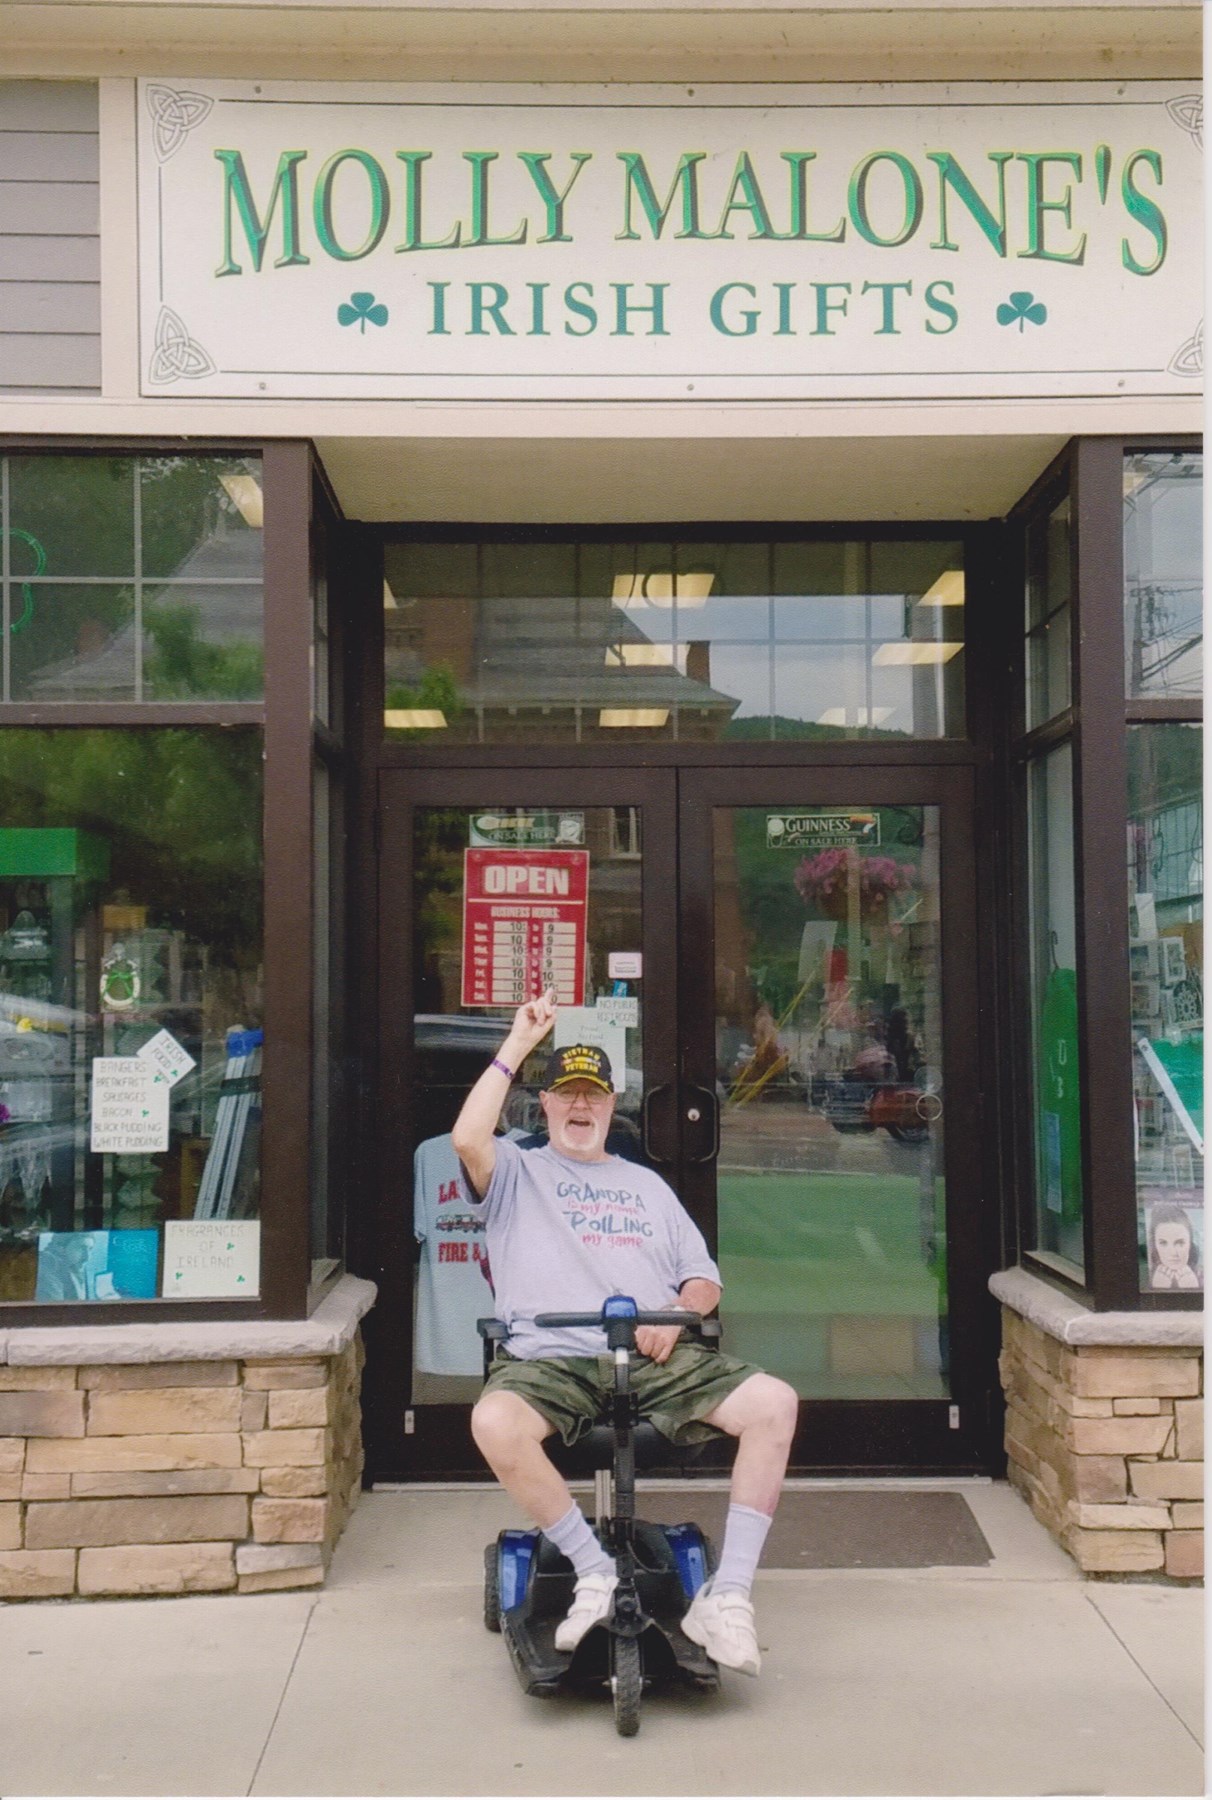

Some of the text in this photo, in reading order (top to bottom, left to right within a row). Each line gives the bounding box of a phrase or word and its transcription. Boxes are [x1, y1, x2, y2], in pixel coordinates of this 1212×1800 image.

[213, 144, 1168, 278] MOLLY MALONE'S
[426, 280, 959, 337] IRISH GIFTS
[785, 818, 851, 832] GUINNESS
[484, 865, 569, 895] OPEN
[512, 969, 524, 979] 10
[512, 981, 524, 991] 10
[99, 1062, 147, 1073] BANGERS
[102, 1107, 133, 1118] BACON
[438, 1180, 461, 1205] LA
[556, 1181, 646, 1212] GRANDPA
[171, 1225, 244, 1237] FRAGRANCES
[562, 1211, 653, 1237] POILING
[199, 1241, 215, 1252] OF
[582, 1235, 644, 1249] my game
[438, 1241, 469, 1263] FIRE
[177, 1256, 234, 1269] IRELAND
